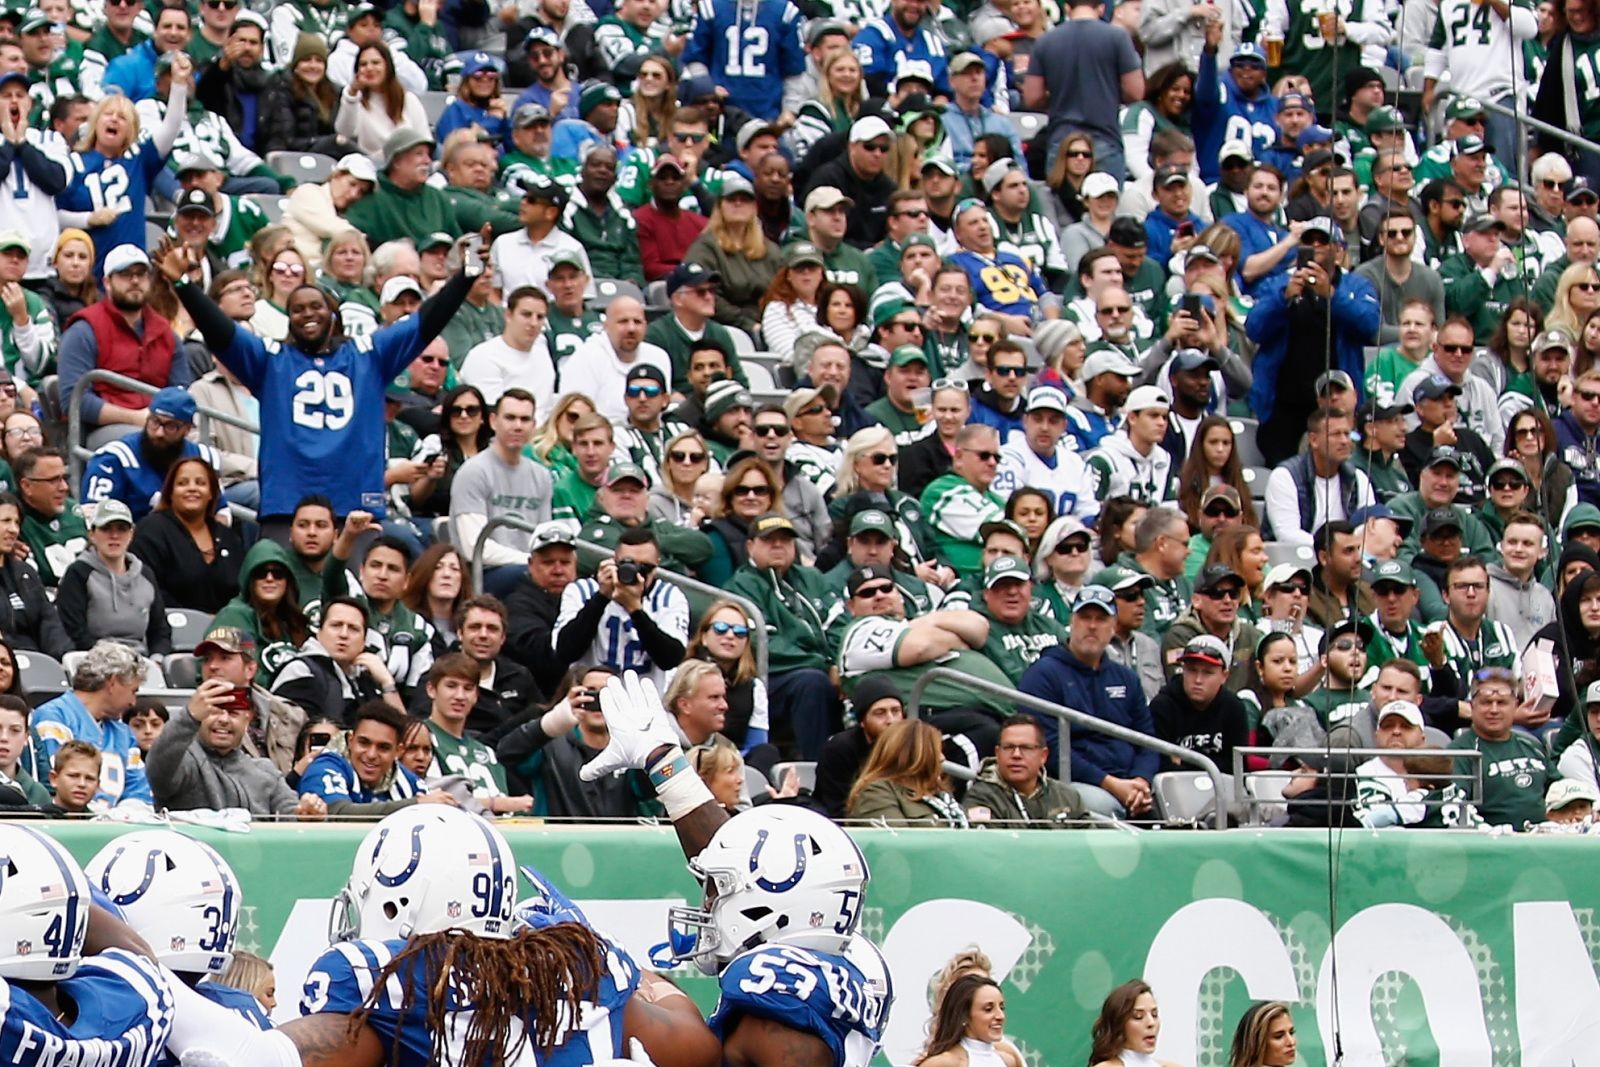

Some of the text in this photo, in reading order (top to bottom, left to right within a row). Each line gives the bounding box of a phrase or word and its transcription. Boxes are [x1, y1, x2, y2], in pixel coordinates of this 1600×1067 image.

[1451, 5, 1491, 45] 24
[725, 26, 770, 77] 12
[85, 164, 132, 213] 12
[979, 264, 1039, 305] 93
[292, 369, 354, 432] 29
[86, 475, 114, 501] 12
[492, 494, 543, 511] JETS
[605, 614, 646, 671] 12
[864, 624, 895, 653] 75
[322, 771, 350, 796] 13
[1488, 757, 1548, 777] JETS
[470, 872, 515, 922] 93
[739, 955, 817, 1000] 53
